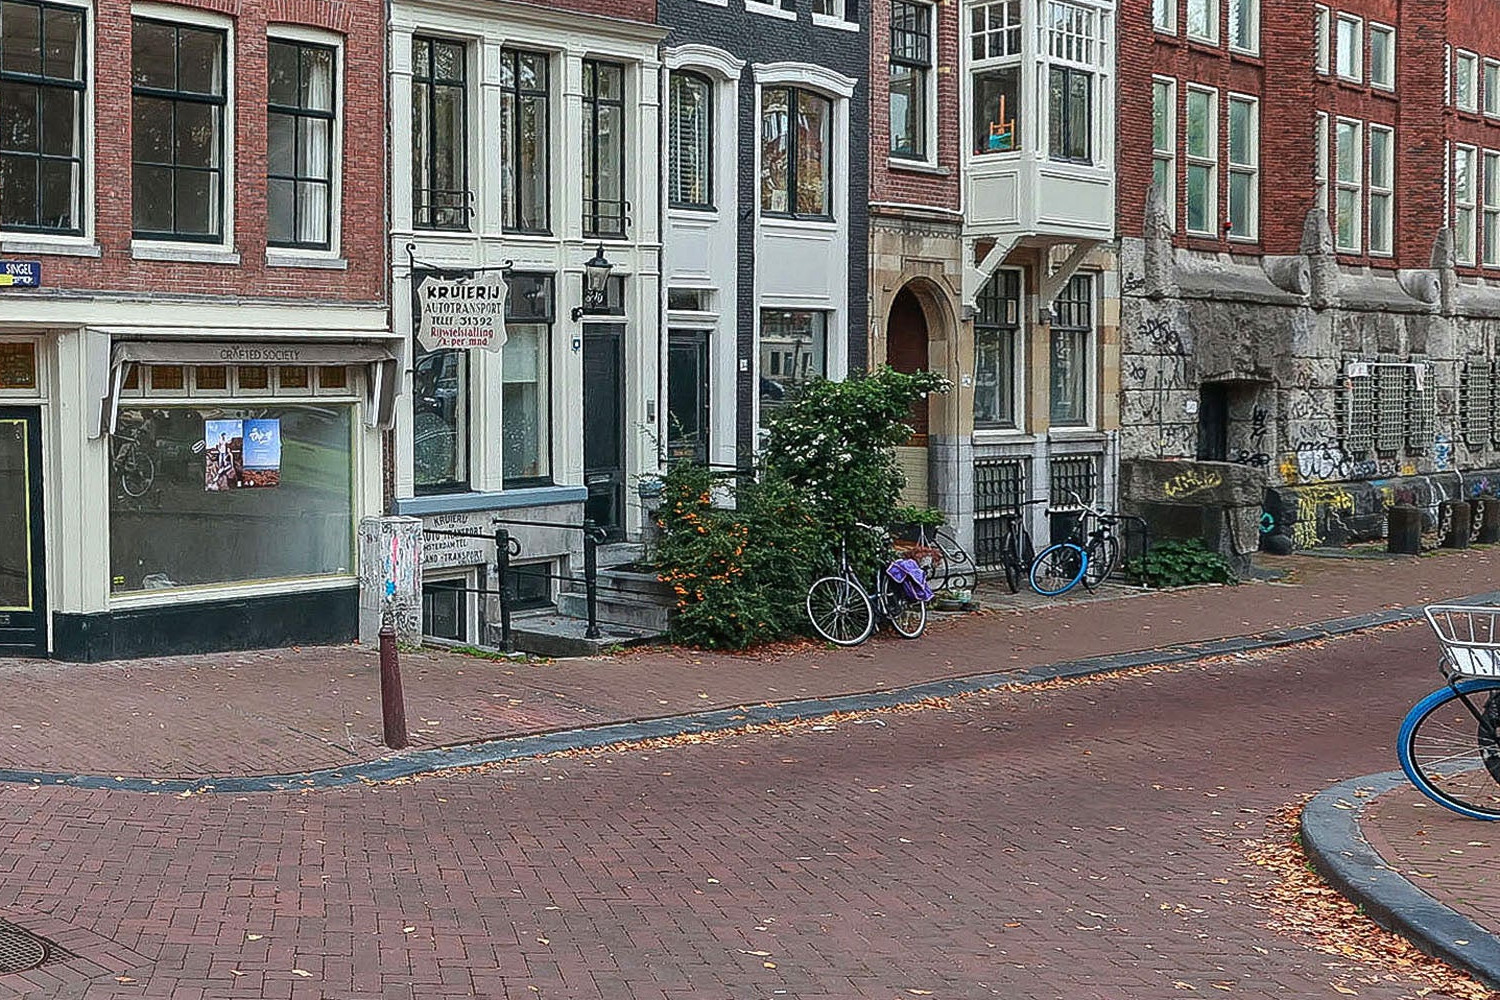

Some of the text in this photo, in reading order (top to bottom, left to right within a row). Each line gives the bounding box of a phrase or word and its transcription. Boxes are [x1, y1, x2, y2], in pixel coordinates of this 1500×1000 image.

[5, 263, 33, 275] SINGEL
[426, 286, 500, 300] KRUIERIJ
[424, 302, 502, 315] AUTOTRANSPORT
[459, 316, 493, 326] 31392
[430, 326, 494, 339] Rijwielstalling
[220, 348, 301, 361] CRAFTED SOCIETY
